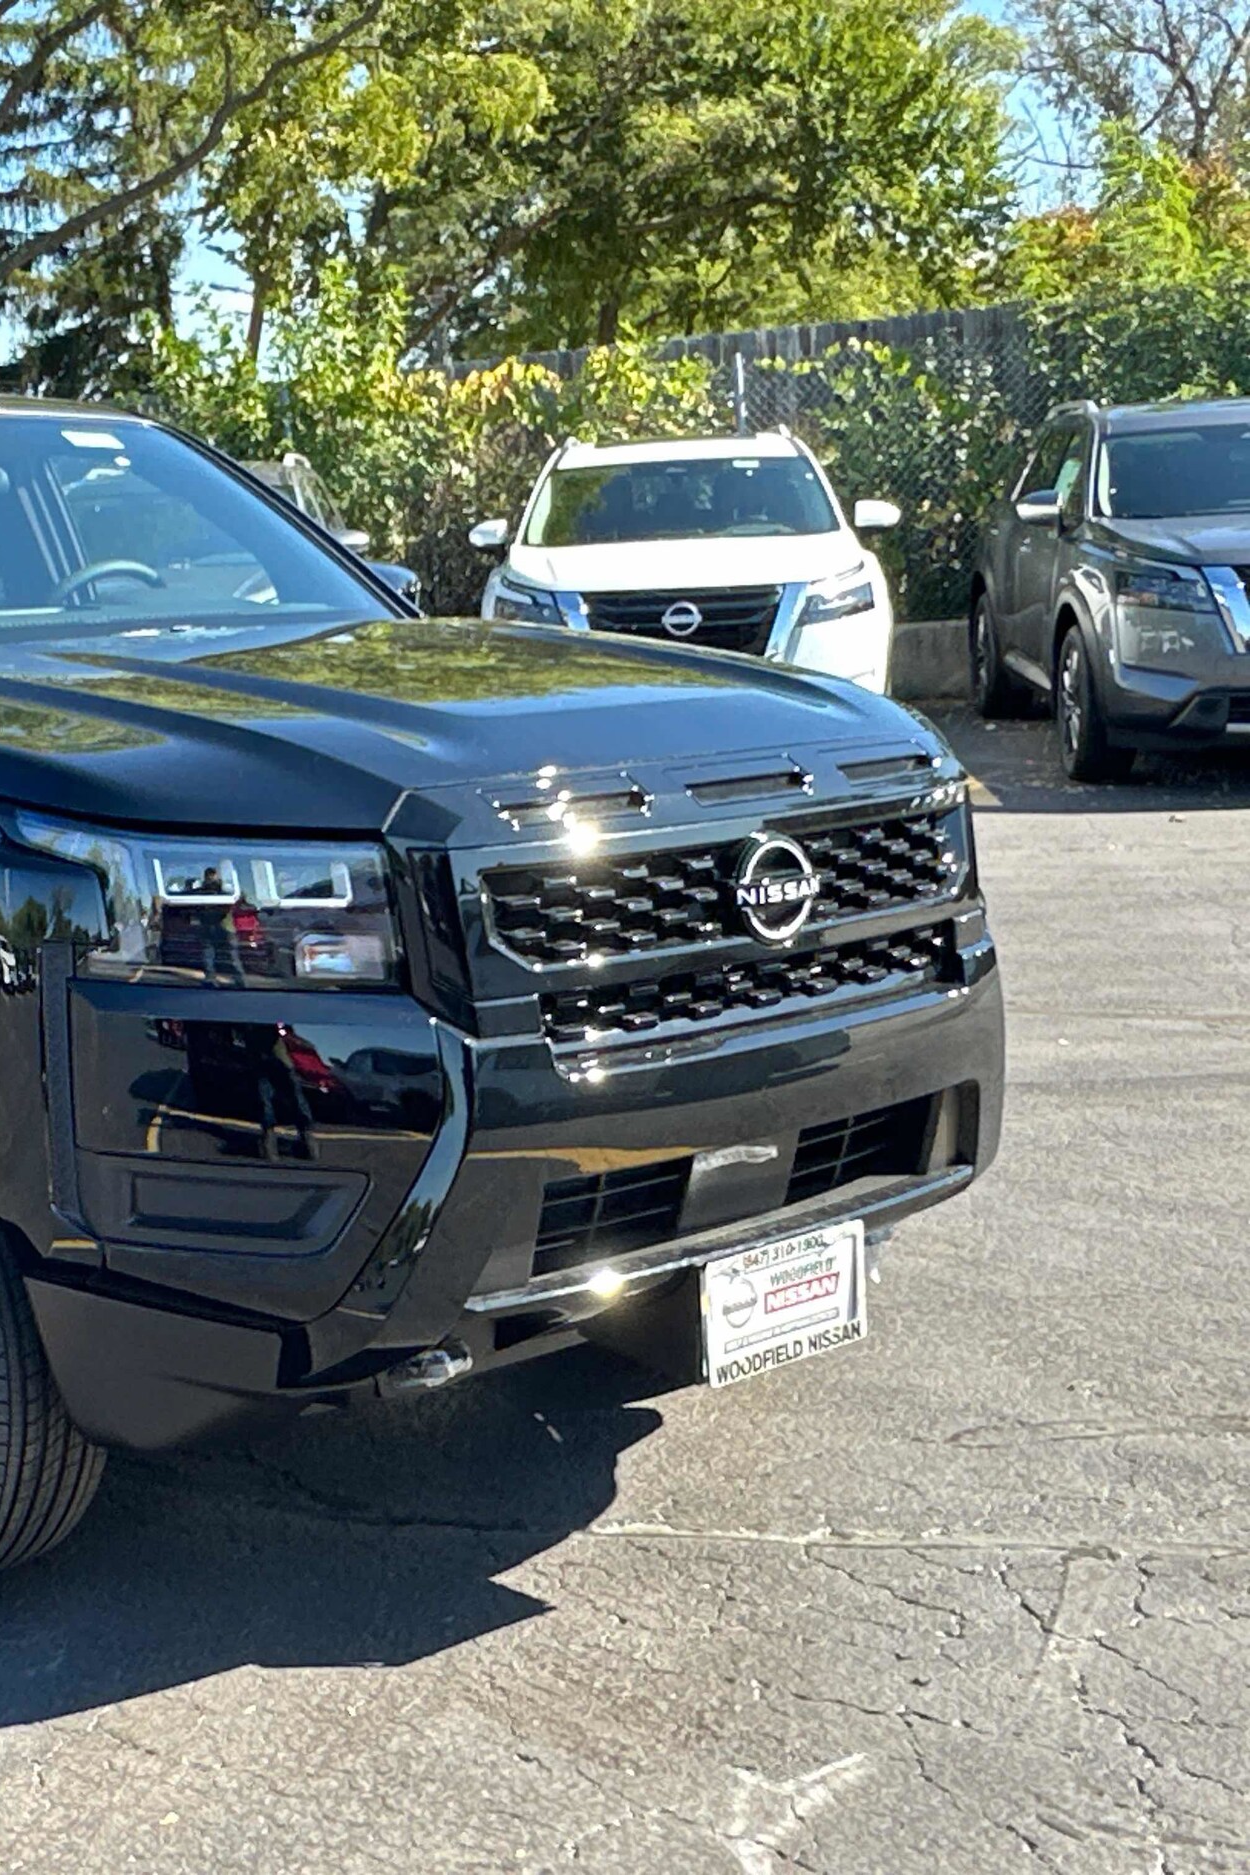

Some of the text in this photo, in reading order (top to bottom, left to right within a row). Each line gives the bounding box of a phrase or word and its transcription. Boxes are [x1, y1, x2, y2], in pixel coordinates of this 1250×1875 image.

[736, 878, 820, 905] NISSAN
[767, 1274, 837, 1312] NISSAN
[716, 1320, 862, 1384] WOODFIELD NISSAN
